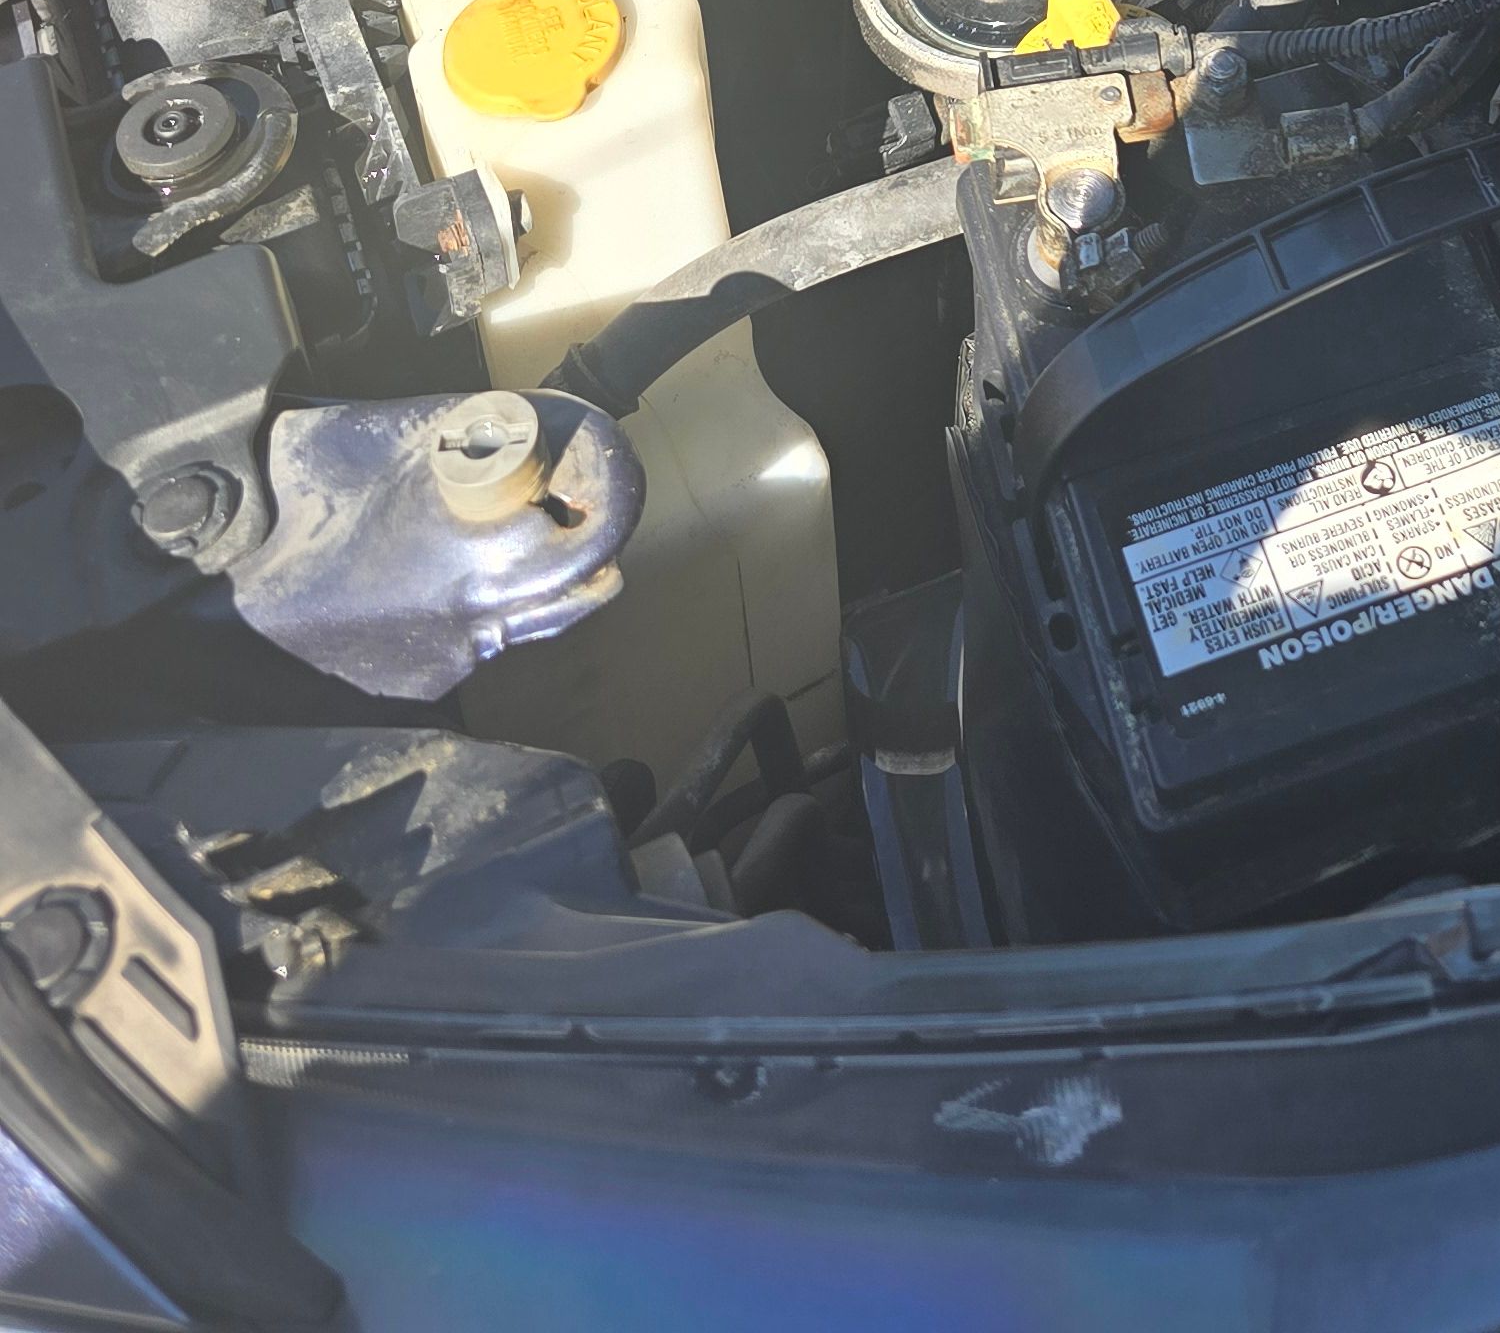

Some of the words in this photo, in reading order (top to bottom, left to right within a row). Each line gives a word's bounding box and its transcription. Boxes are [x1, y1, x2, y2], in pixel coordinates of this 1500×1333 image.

[1427, 389, 1500, 426] RECOMMENDED
[1457, 410, 1483, 428] RISK
[1359, 420, 1408, 448] INVERTED
[1407, 415, 1429, 432] FOR
[1443, 418, 1459, 433] OF
[1364, 431, 1420, 461] EXPLOSION
[1454, 433, 1471, 449] OF
[1463, 442, 1486, 460] OUT
[1295, 444, 1338, 470] FOLLOW
[1348, 449, 1366, 466] OR
[1397, 438, 1455, 470] CHILDREN.
[1423, 457, 1445, 474] THE
[1445, 451, 1462, 466] OF
[1255, 459, 1297, 484] PROPER
[1273, 473, 1297, 491] NOT
[1295, 468, 1312, 484] DO
[1203, 472, 1256, 501] CHARGING
[1204, 480, 1275, 516] DISASSEMBLE
[1272, 471, 1357, 512] INSTRUCTIONS.
[1331, 486, 1362, 506] READ
[1126, 489, 1205, 528] INSTRUCTIONS.
[1188, 505, 1206, 520] OR
[1242, 505, 1263, 522] DO
[1308, 496, 1331, 514] ALL
[1372, 493, 1425, 521] SMOKING
[1126, 509, 1190, 542] INCINERATE.
[1214, 511, 1243, 532] NOT
[1248, 518, 1268, 535] DO
[1320, 514, 1365, 540] SEVERE
[1385, 505, 1430, 531] FLAMES
[1189, 522, 1214, 540] TIP.
[1222, 524, 1249, 544] NOT
[1275, 530, 1321, 556] BURNS.
[1391, 518, 1436, 544] SPARKS
[1189, 533, 1223, 555] OPEN
[1306, 529, 1371, 562] BLINDNESS
[1350, 543, 1376, 562] CAN
[1433, 542, 1454, 560] NO
[1134, 545, 1190, 575] BATTERY.
[1287, 552, 1307, 568] OR
[1312, 552, 1352, 576] CAUSE
[1350, 558, 1383, 581] ACID
[1178, 562, 1216, 587] HELP
[1139, 575, 1179, 601] FAST.
[1143, 583, 1207, 617] MEDICAL
[1235, 582, 1273, 607] WITH
[1323, 574, 1391, 610] SULFURIC
[1148, 609, 1179, 633] GET
[1181, 595, 1236, 627] WATER.
[1185, 597, 1280, 643] IMMEDIATELY
[1256, 564, 1495, 670] DANGER/POISON
[1240, 612, 1286, 641] FLUSH
[1202, 628, 1240, 655] EYES
